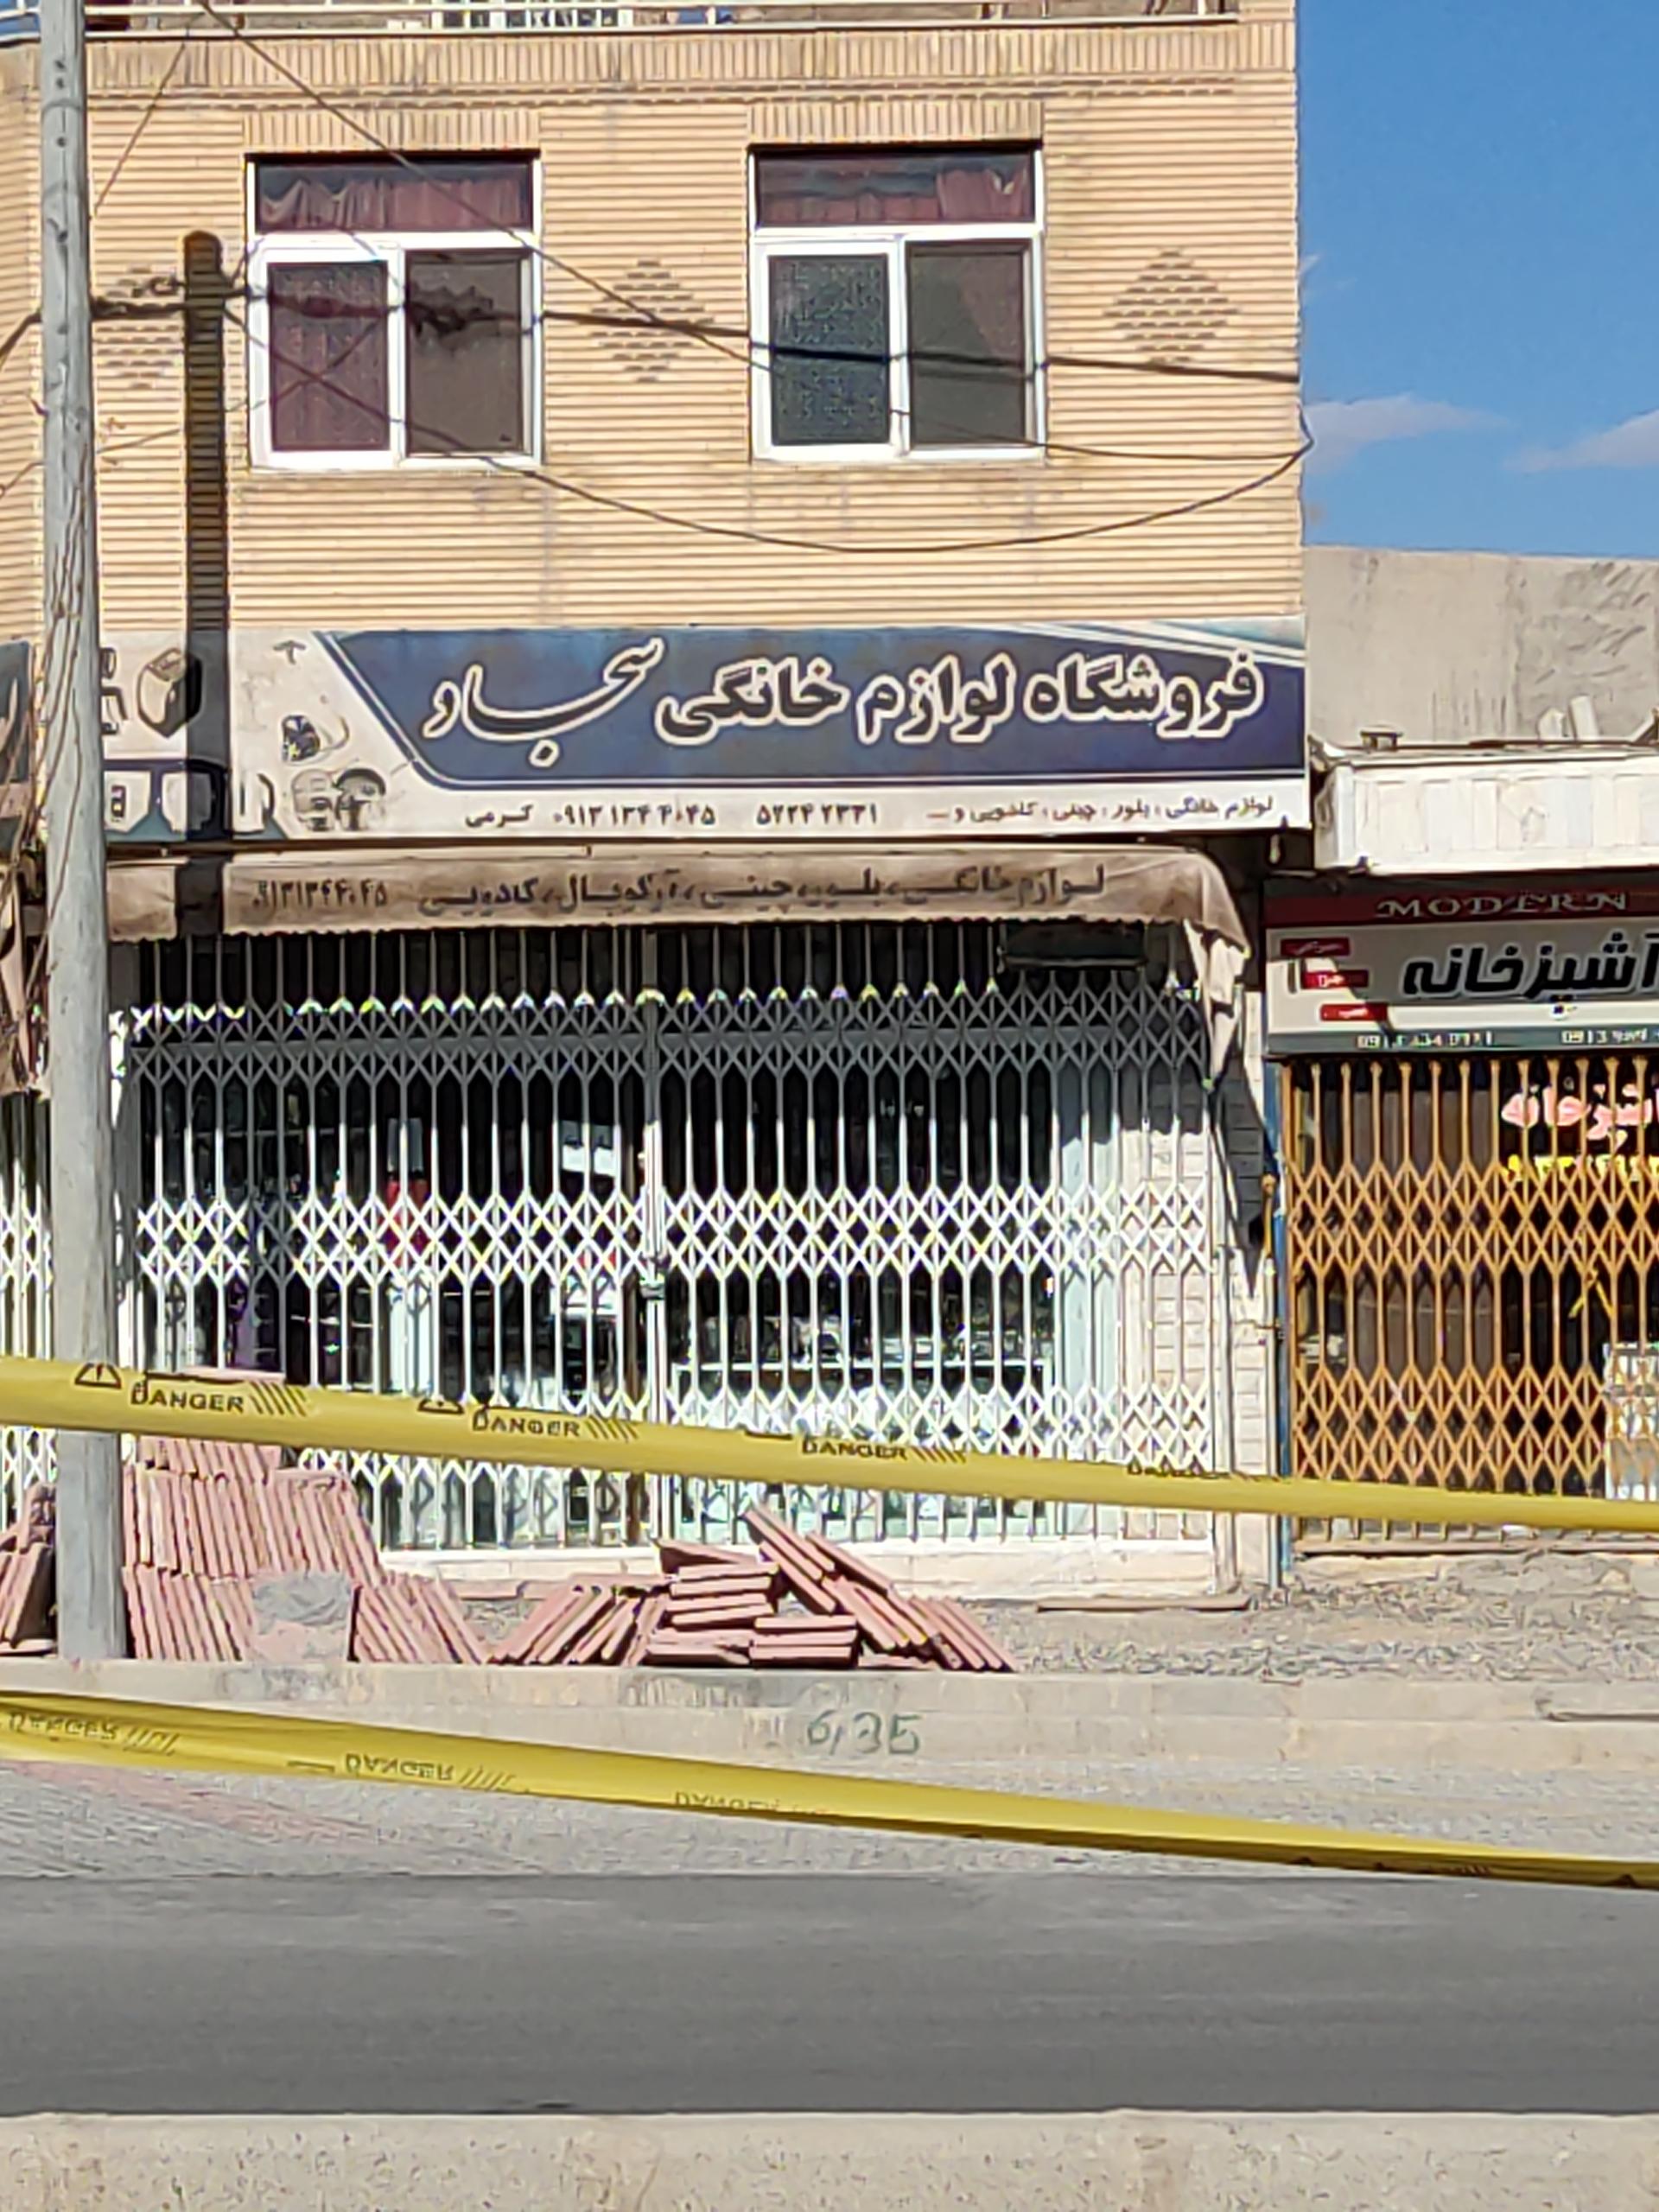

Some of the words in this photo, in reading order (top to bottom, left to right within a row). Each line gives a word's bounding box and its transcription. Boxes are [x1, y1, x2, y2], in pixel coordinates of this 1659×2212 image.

[423, 637, 664, 767] سجاد
[655, 655, 849, 745] خانگی
[856, 652, 1017, 744] لوازم
[1026, 646, 1265, 737] فروشگاه
[466, 804, 533, 828] کرمی
[1225, 795, 1273, 819] لوازم
[1376, 891, 1628, 918] MODERN
[130, 1382, 245, 1413] DANGER
[473, 1408, 580, 1437] DANGER
[802, 1439, 906, 1460] DANGER
